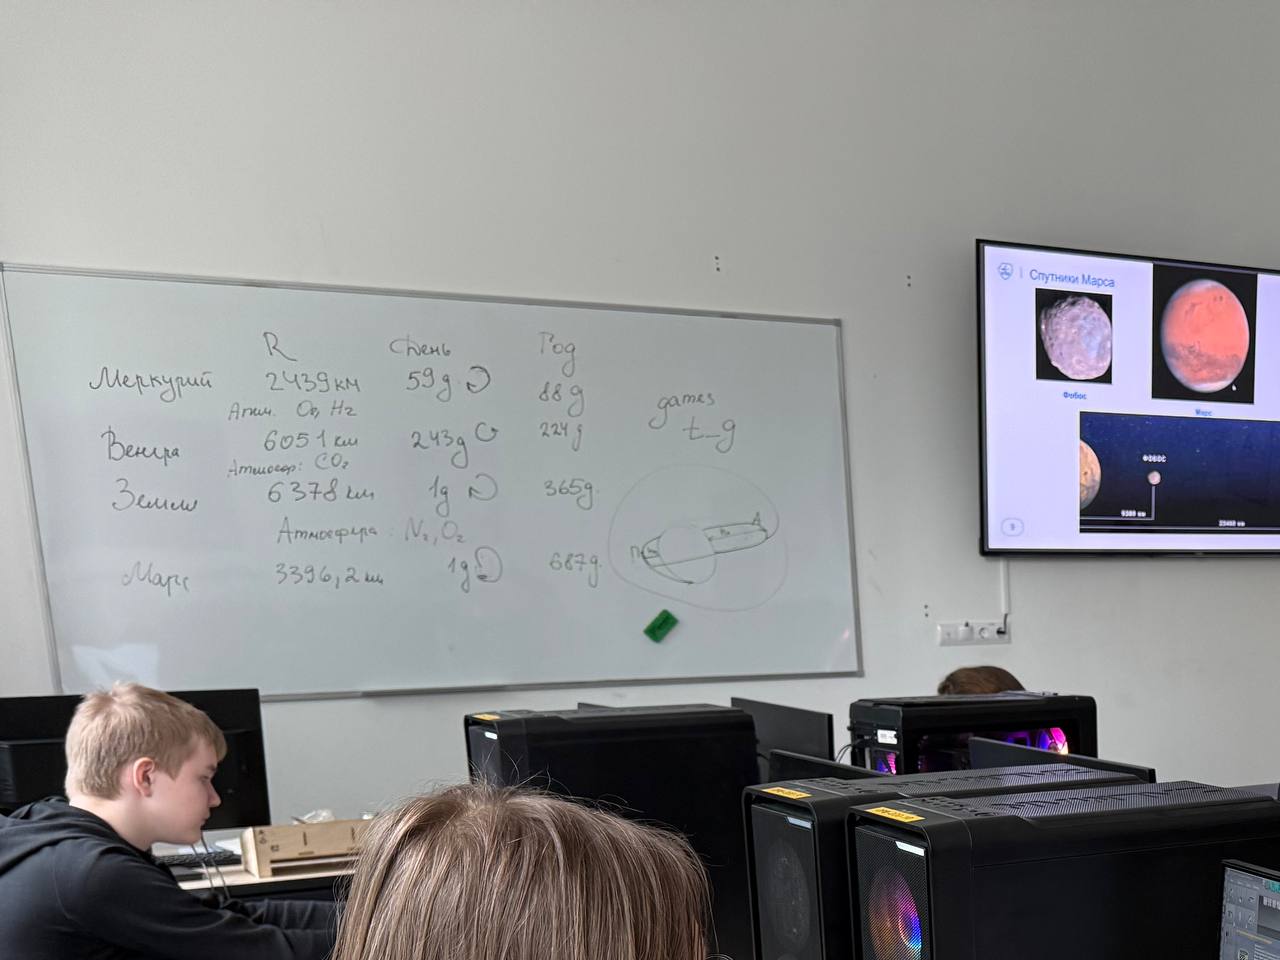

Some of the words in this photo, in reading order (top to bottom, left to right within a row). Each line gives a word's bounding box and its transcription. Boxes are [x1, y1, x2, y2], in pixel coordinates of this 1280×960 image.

[1029, 269, 1079, 284] Спутники
[1081, 274, 1115, 288] Марса
[263, 331, 297, 361] R
[648, 391, 716, 430] games
